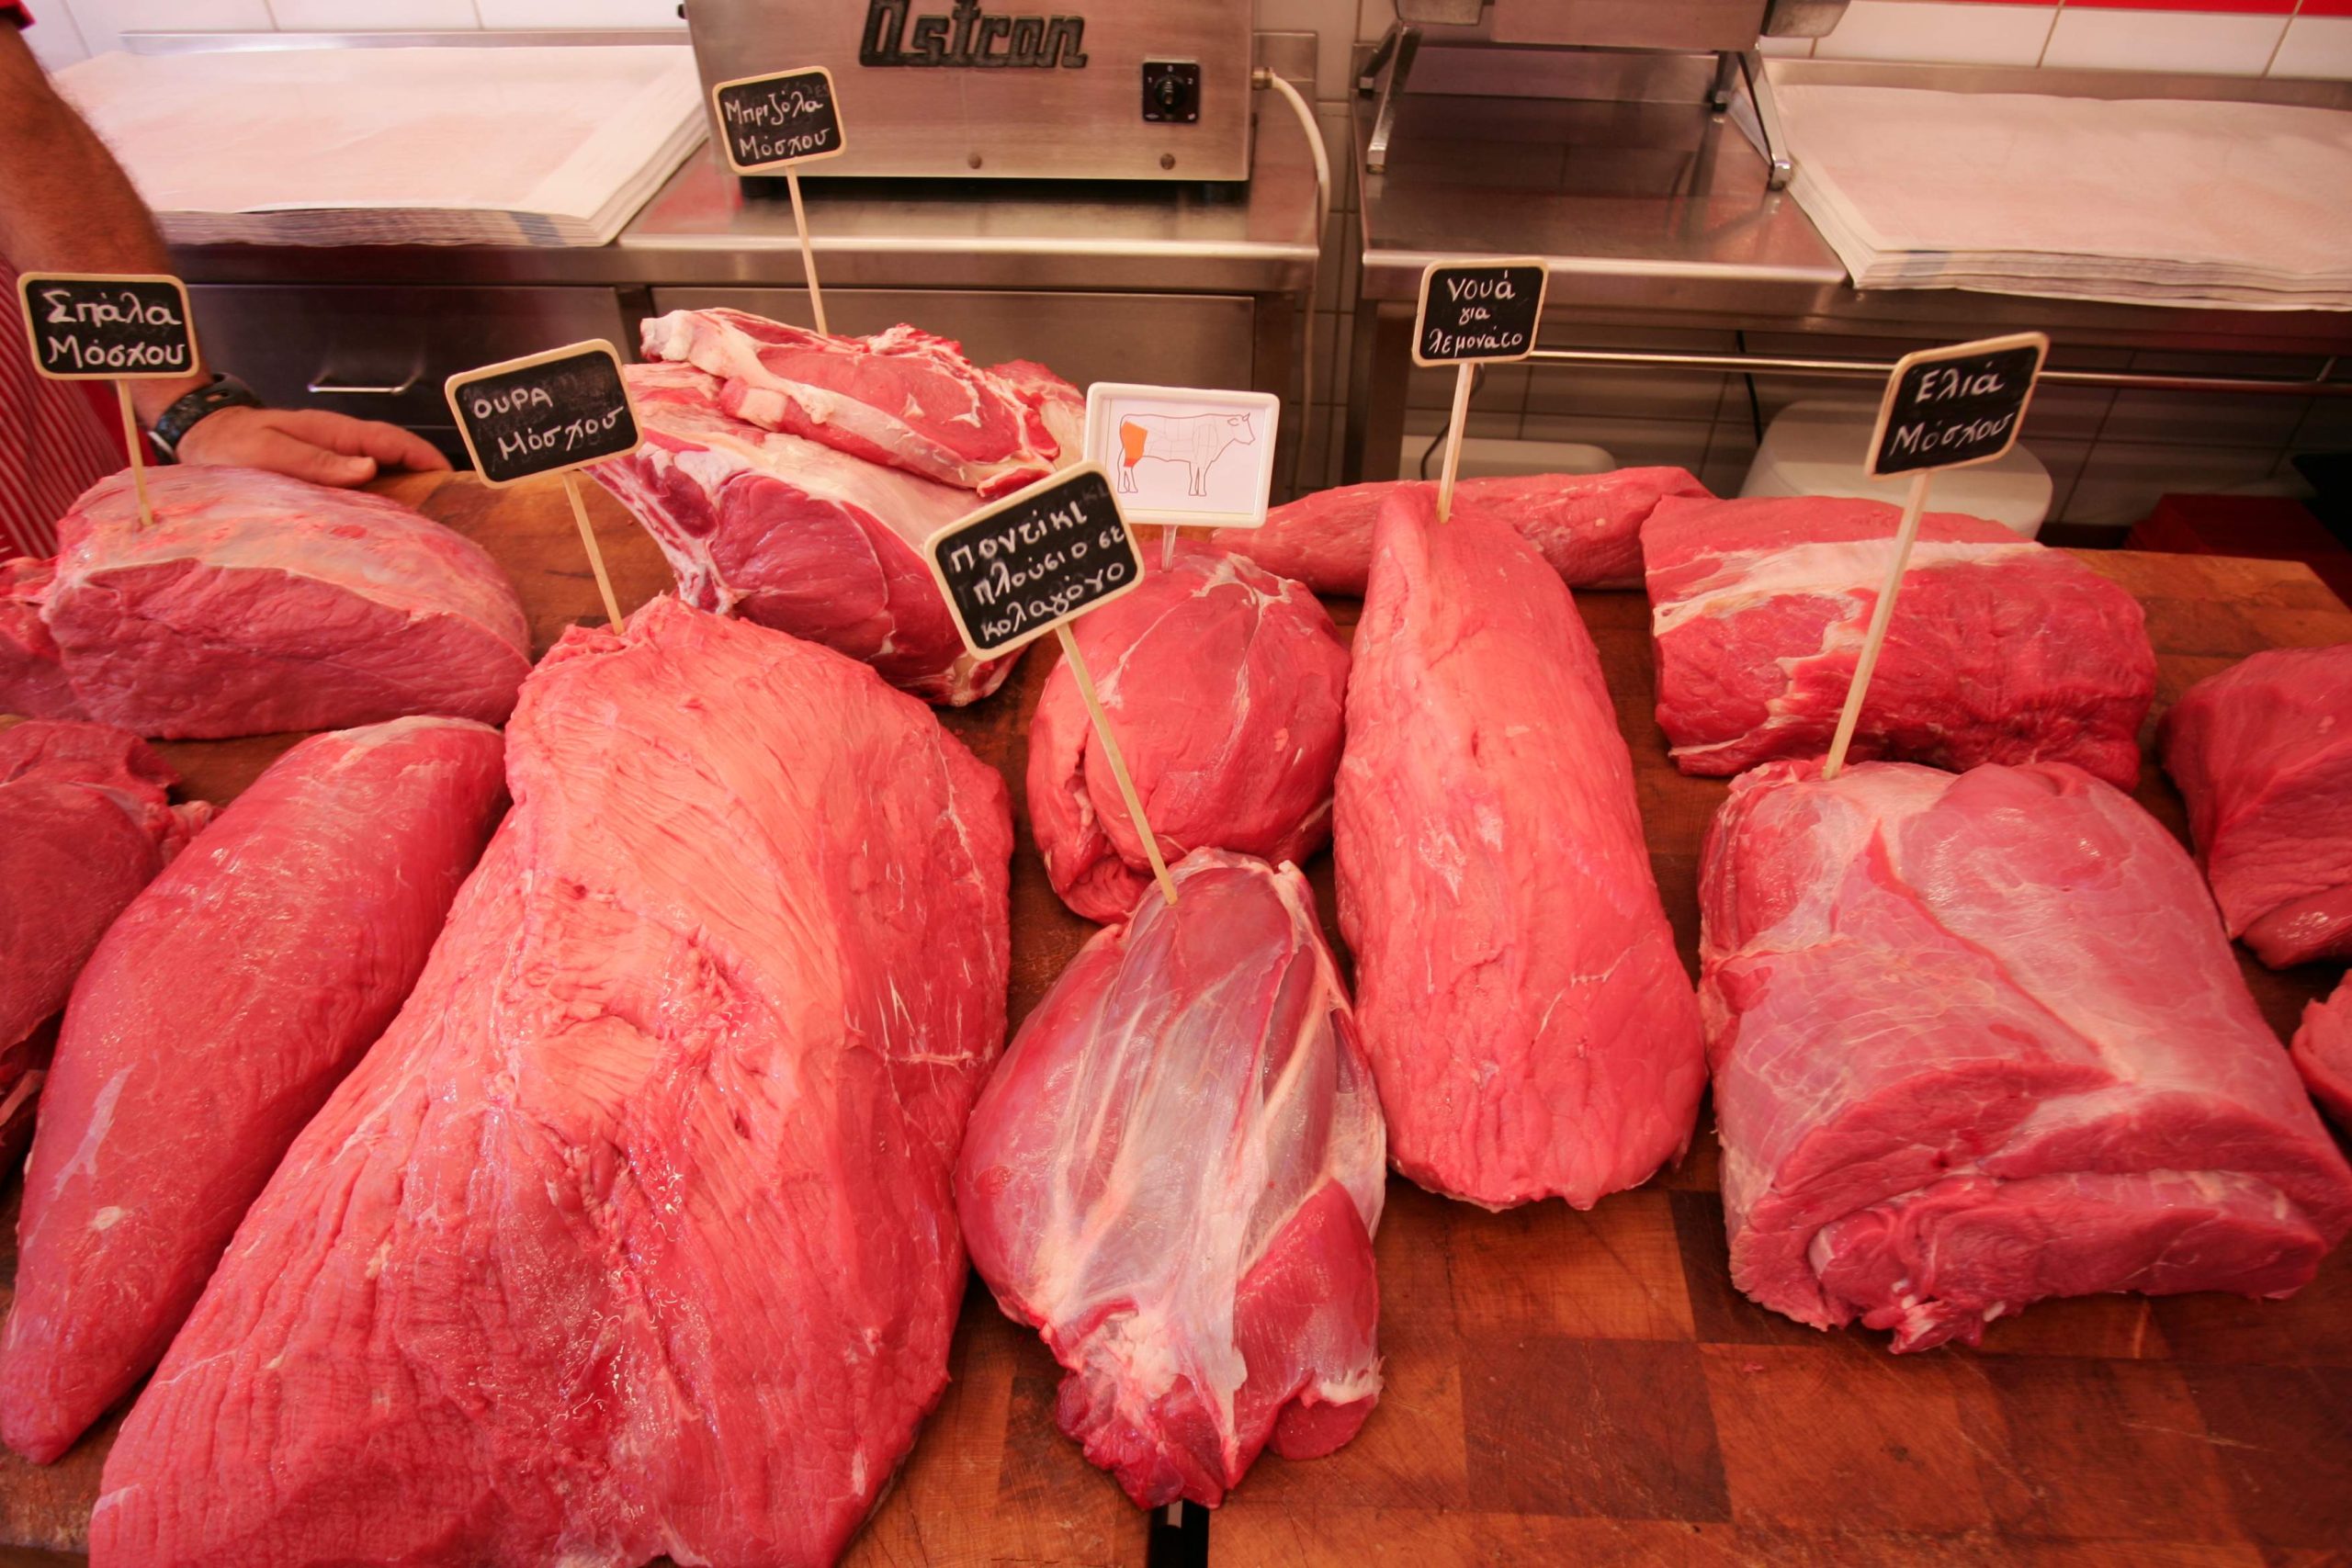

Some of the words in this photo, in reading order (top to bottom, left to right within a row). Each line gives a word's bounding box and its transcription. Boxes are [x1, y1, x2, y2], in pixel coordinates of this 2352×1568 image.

[724, 90, 824, 127] Μπριζόλα
[739, 128, 831, 160] Μόσχου
[42, 289, 183, 328] Σπάλα
[1458, 306, 1491, 326] για
[47, 334, 186, 368] Μόσχου
[1428, 325, 1523, 358] λεμονάτο
[1916, 360, 2007, 404] Ελιά
[497, 406, 624, 460] Μόσχου
[1889, 412, 2015, 457] Μόσχου
